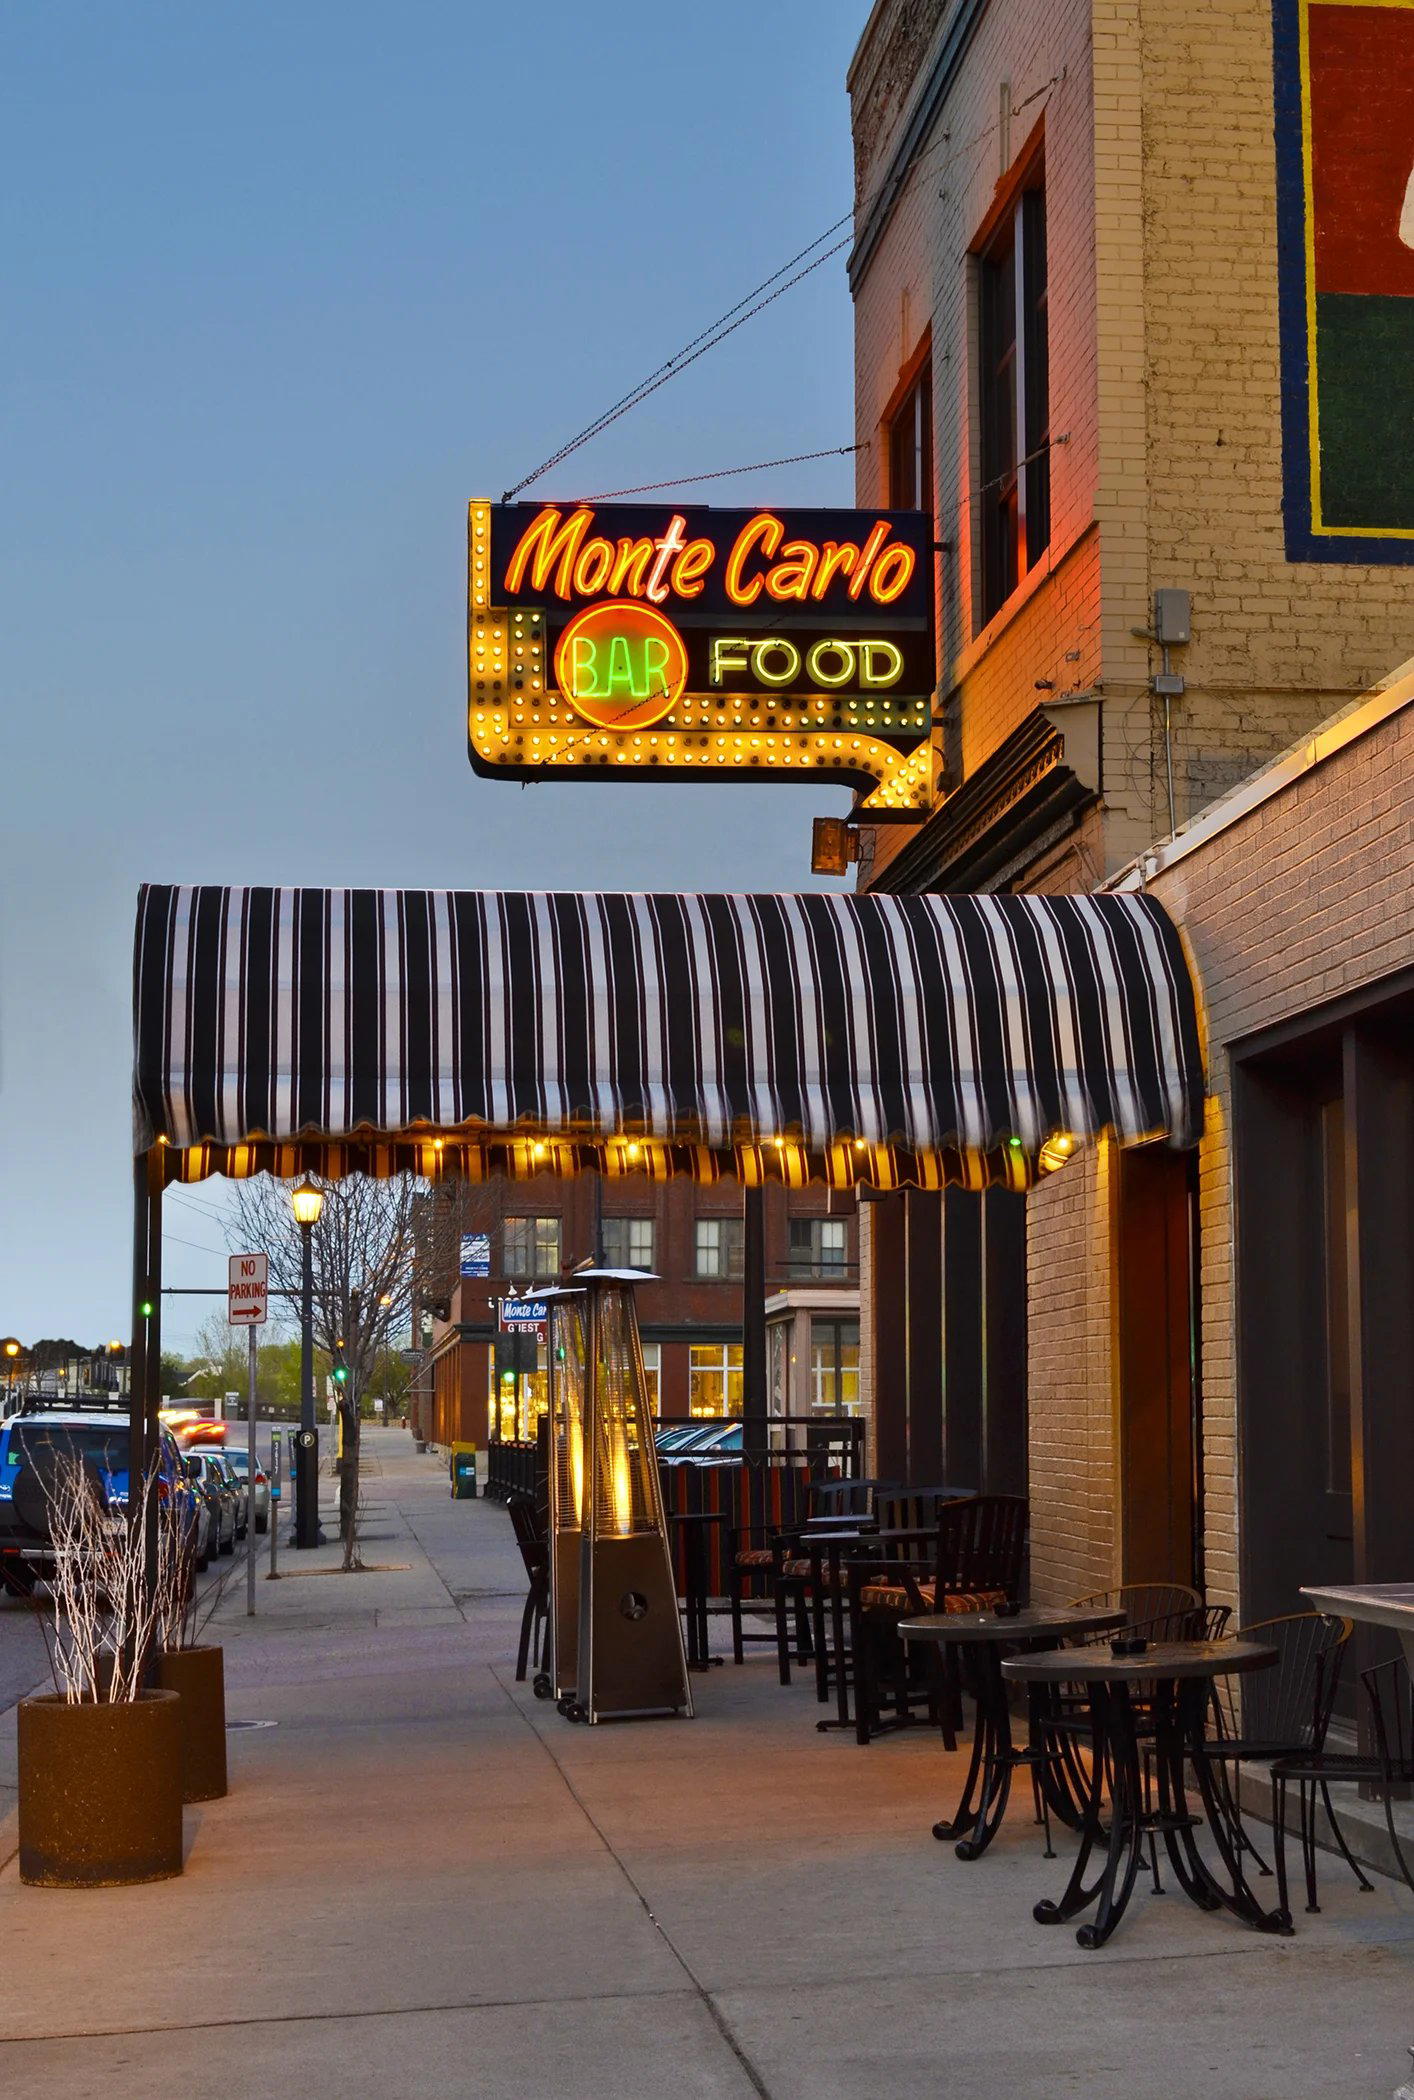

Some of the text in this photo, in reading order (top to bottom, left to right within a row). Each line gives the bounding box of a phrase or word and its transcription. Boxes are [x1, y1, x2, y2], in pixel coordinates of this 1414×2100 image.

[504, 507, 916, 607] Monte Carlo
[572, 636, 671, 699] BAR
[707, 635, 904, 688] FOOD
[241, 1260, 256, 1277] NO
[230, 1281, 266, 1300] PARKING
[504, 1302, 532, 1318] Monte
[532, 1302, 547, 1317] Car
